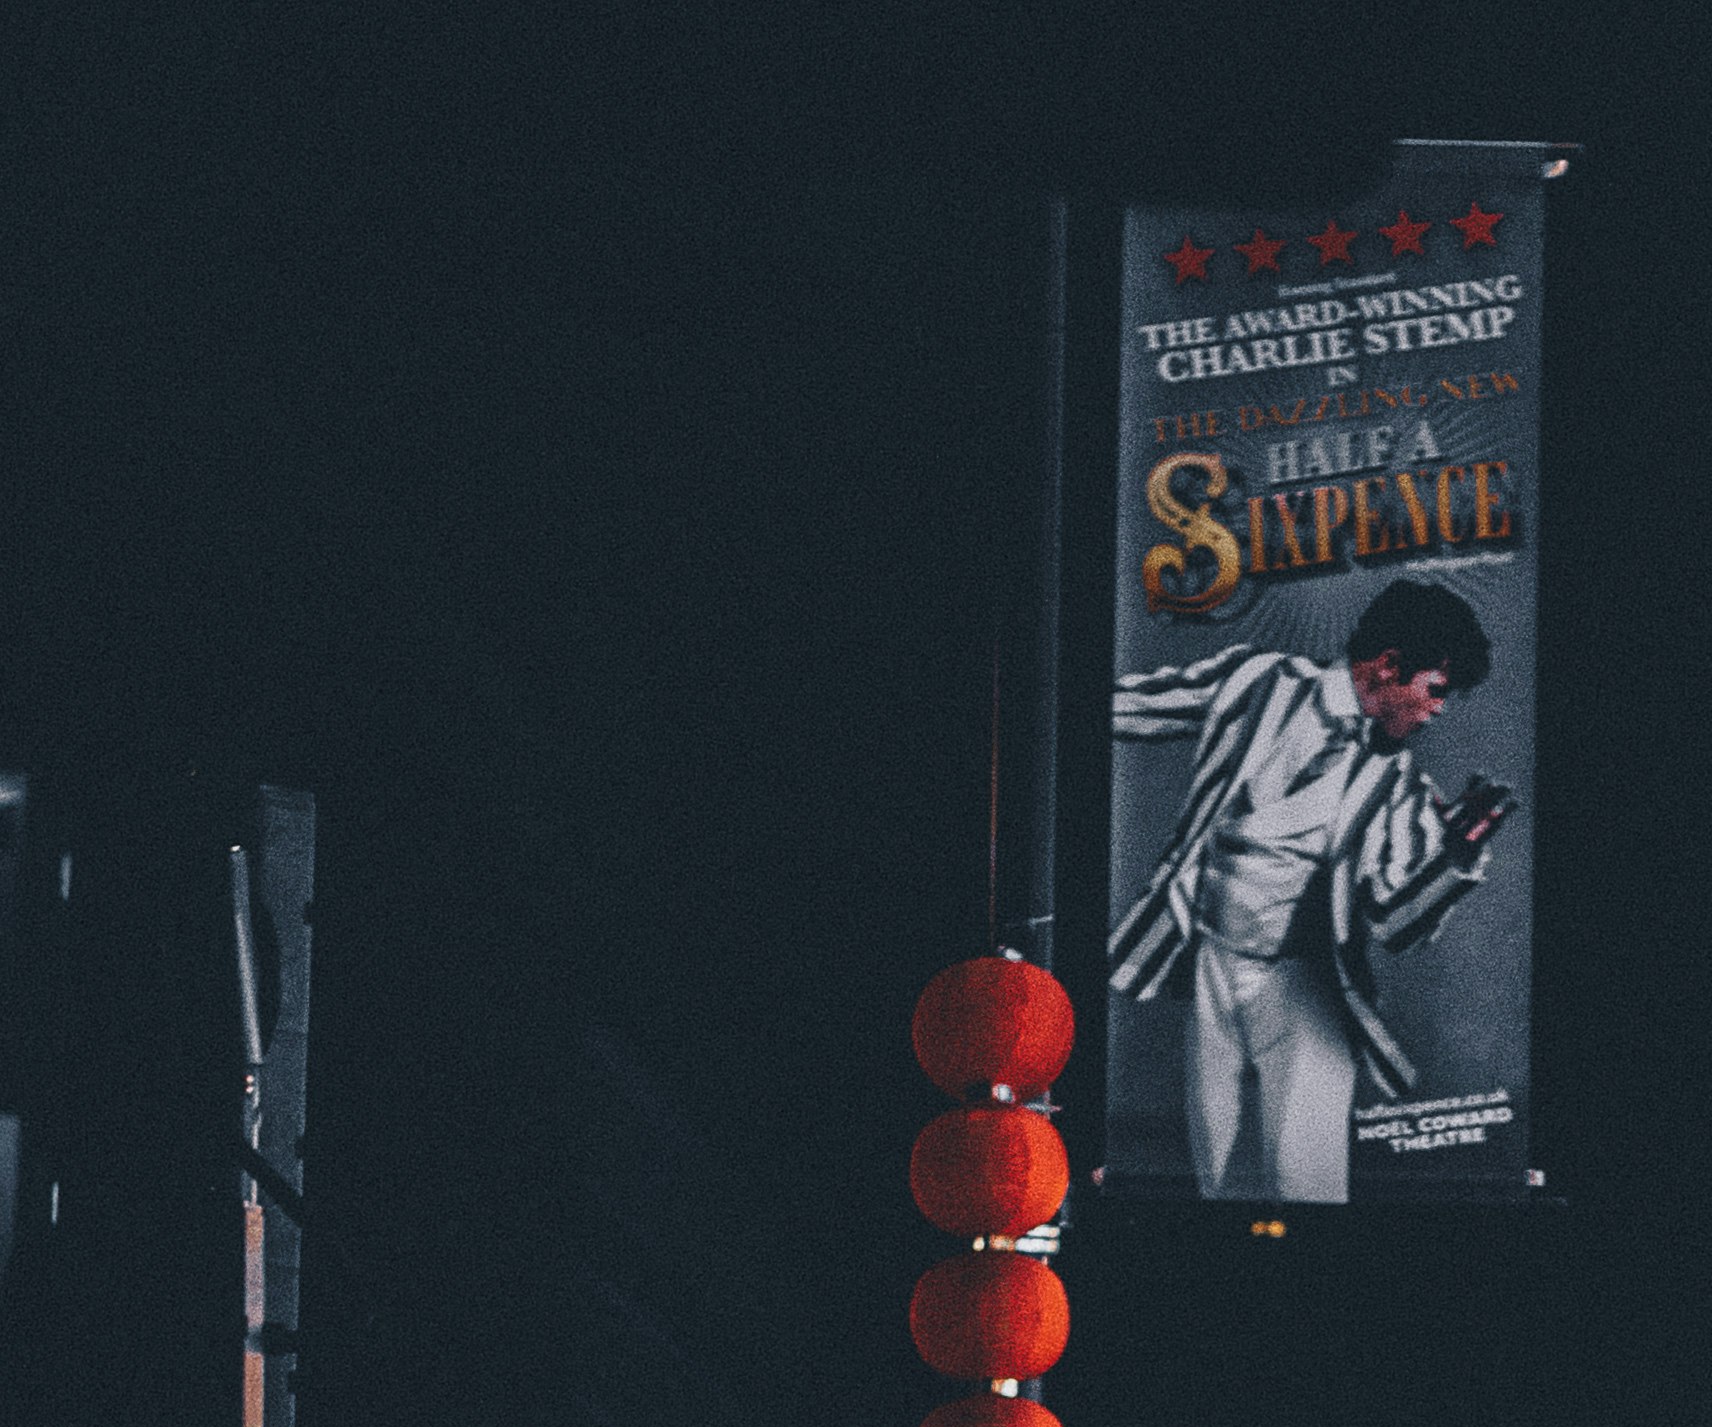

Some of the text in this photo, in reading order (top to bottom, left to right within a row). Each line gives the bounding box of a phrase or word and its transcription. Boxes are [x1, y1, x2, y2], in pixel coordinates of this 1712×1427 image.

[1138, 316, 1218, 350] THE
[1223, 274, 1523, 338] AWARD-WINNING
[1157, 305, 1515, 383] CHARLIE STEMP
[1153, 370, 1520, 442] THE DAZZLING NEW
[1327, 364, 1358, 387] IN
[1266, 419, 1441, 485] HALF A
[1142, 452, 1513, 614] SIXPENCE
[1389, 1126, 1486, 1152] THEATRE
[1418, 1106, 1514, 1133] COWARD
